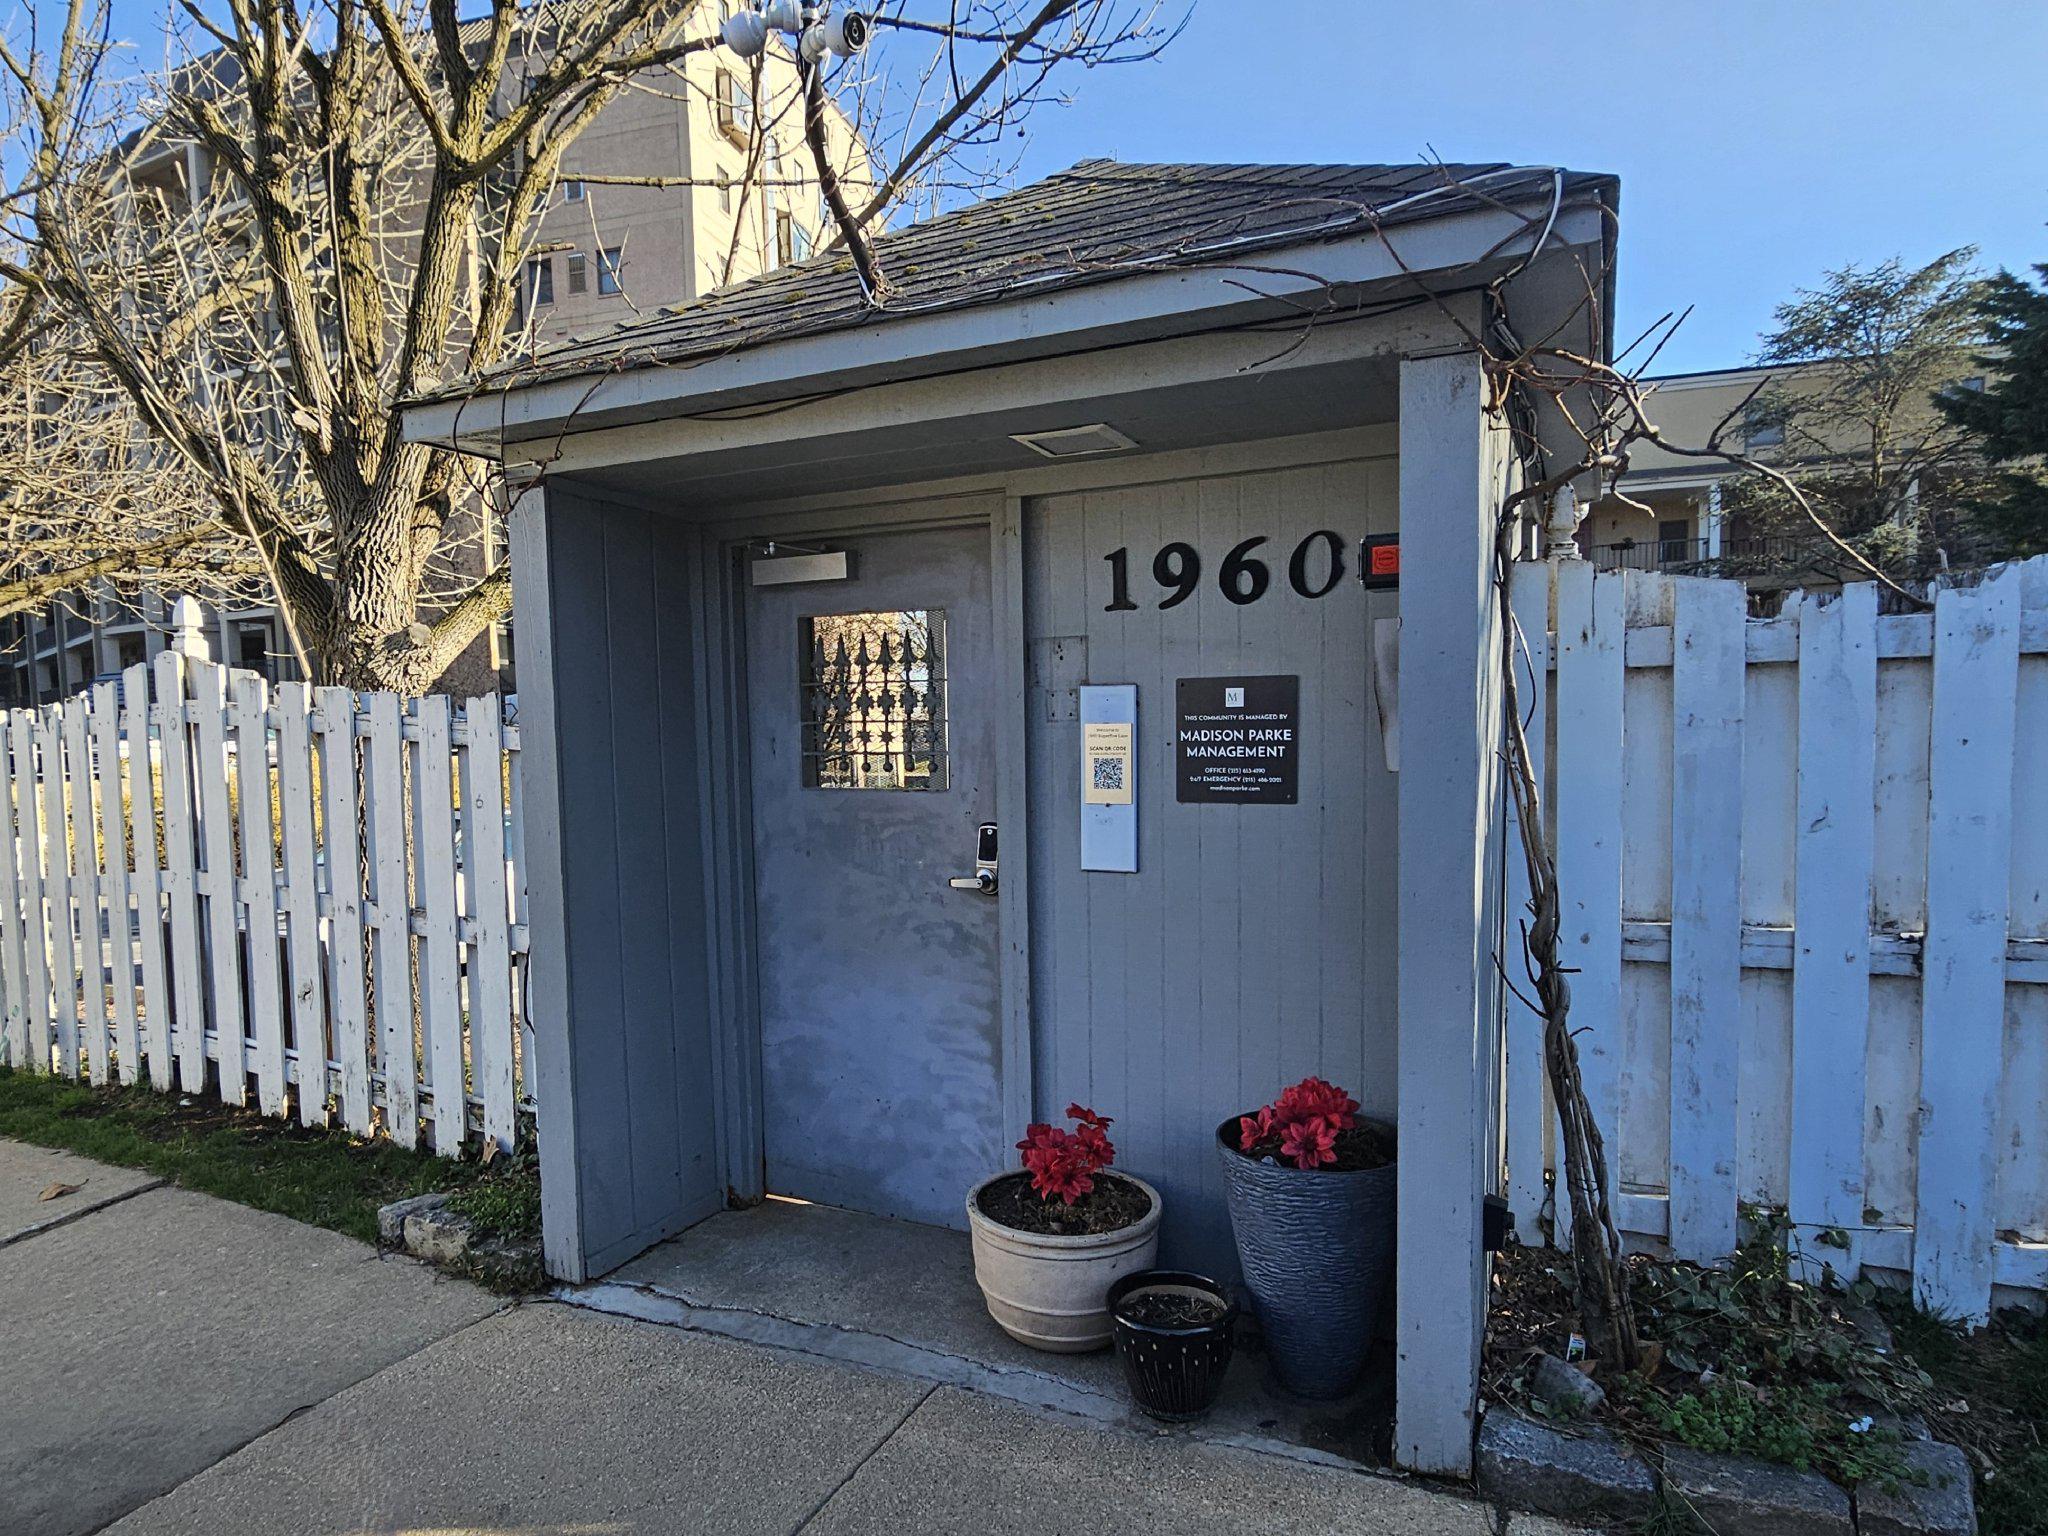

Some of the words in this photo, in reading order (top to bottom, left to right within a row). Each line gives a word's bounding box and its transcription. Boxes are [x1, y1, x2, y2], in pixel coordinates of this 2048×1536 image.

[1103, 530, 1347, 611] 1960
[1227, 692, 1238, 703] M
[1180, 729, 1244, 742] MADISON
[1248, 729, 1293, 741] PARKE
[1186, 746, 1286, 758] MANAGEMENT
